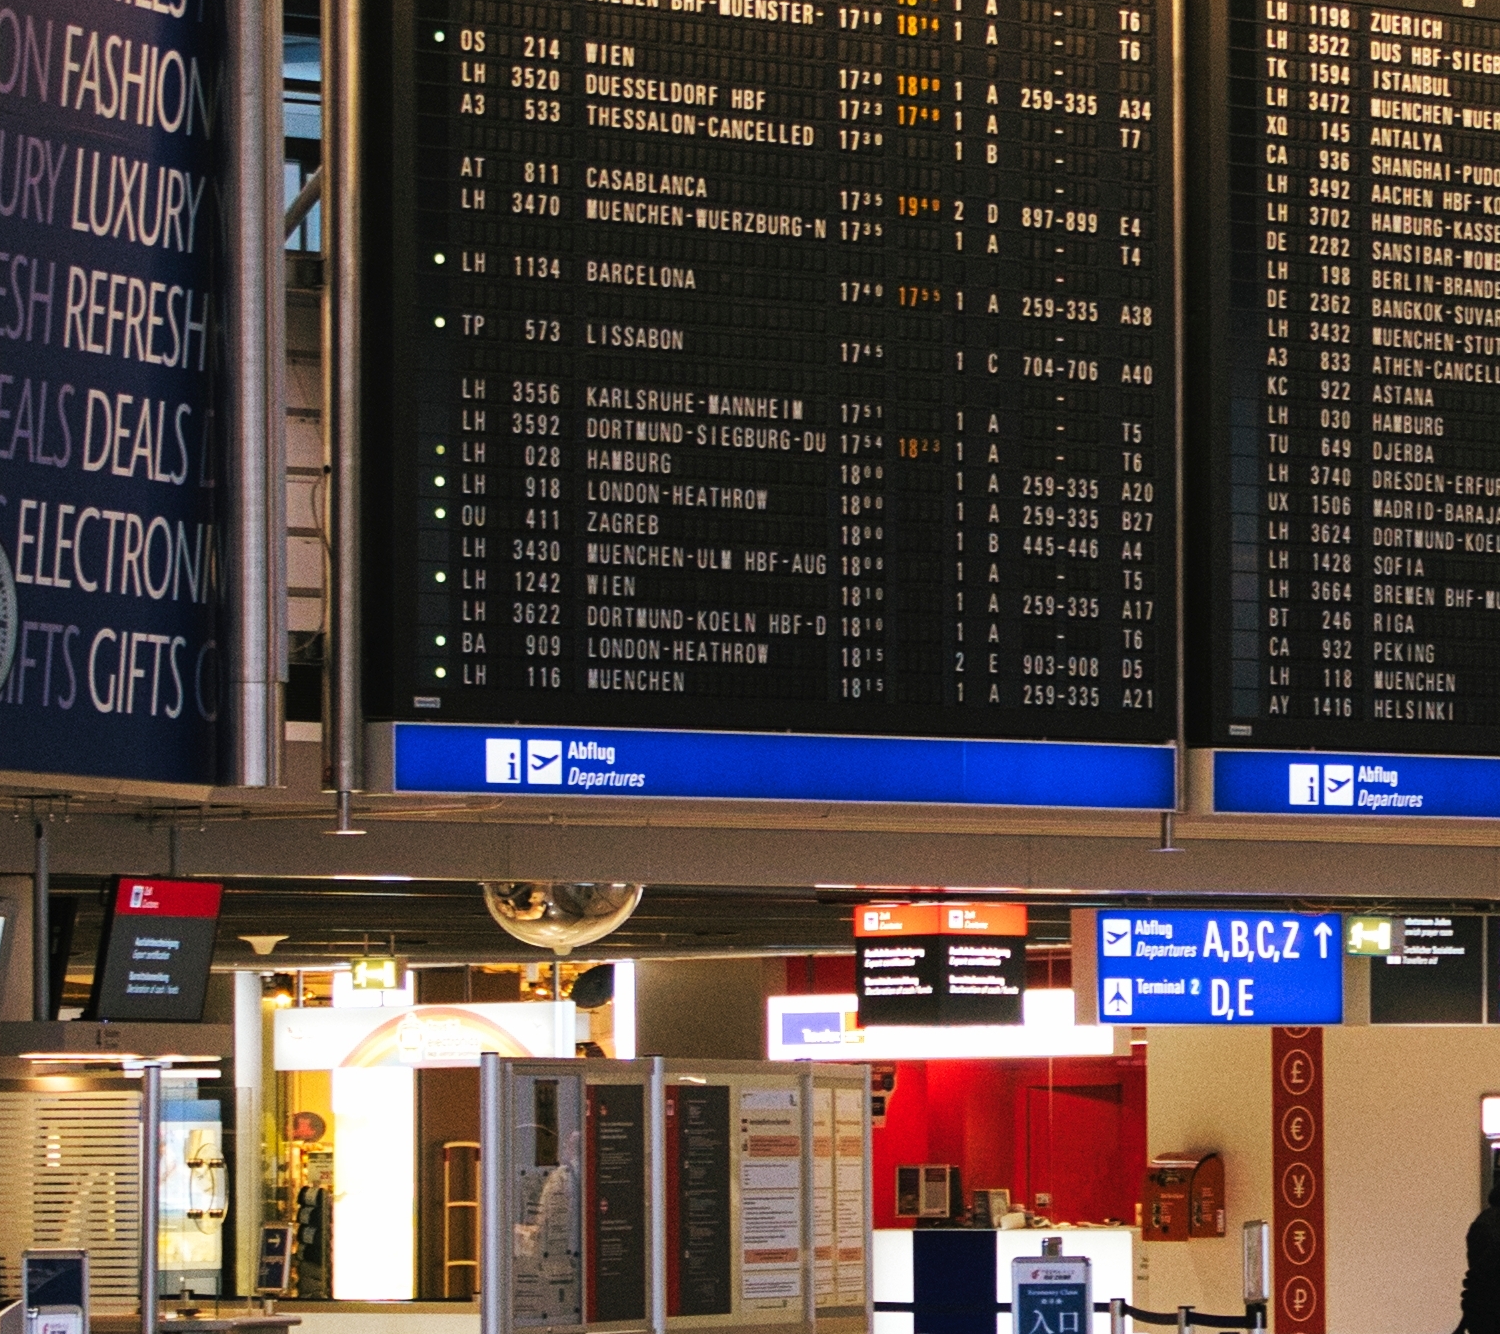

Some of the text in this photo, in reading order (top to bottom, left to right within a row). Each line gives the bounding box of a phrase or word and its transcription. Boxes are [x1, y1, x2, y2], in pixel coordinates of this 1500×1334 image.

[1370, 12, 1443, 39] ZUERICH
[460, 29, 634, 67] OS 214 WIEN
[59, 23, 211, 141] FASHION
[585, 73, 765, 111] DUESSELDORF HBF
[1373, 70, 1451, 97] ISTANBUL
[525, 98, 815, 146] 533 THESSALON-CANCELLED
[1370, 127, 1443, 152] ANTALYA
[586, 166, 707, 197] CASABLANCA
[70, 147, 206, 255] LUXURY
[586, 198, 826, 239] MUENCHEN-WUERZBURG-N
[514, 255, 696, 289] 1134 BARCELONA
[63, 264, 208, 371] REFRESH
[586, 324, 1153, 385] LISSABON A40
[586, 387, 803, 420] KARLSRUHE-MANNHEIM
[1372, 384, 1434, 406] ASTANA
[82, 387, 192, 486] DEALS
[587, 450, 671, 474] HAMBURG
[587, 480, 768, 510] LONDON-HEATHROW
[586, 511, 659, 536] ZAGREB
[1373, 641, 1435, 664] PEKING
[88, 628, 187, 719] GIFTS
[587, 668, 684, 692] MUENCHEN
[1374, 699, 1453, 720] HELSINKI
[568, 742, 615, 764] Abflug
[568, 767, 645, 789] Departures
[1358, 766, 1398, 787] Abflug
[1358, 790, 1423, 810] Departures
[1135, 920, 1173, 940] Abflug
[1136, 942, 1198, 960] Departures
[1137, 978, 1200, 995] Terminal 2
[1028, 1309, 1078, 1334] 入口
